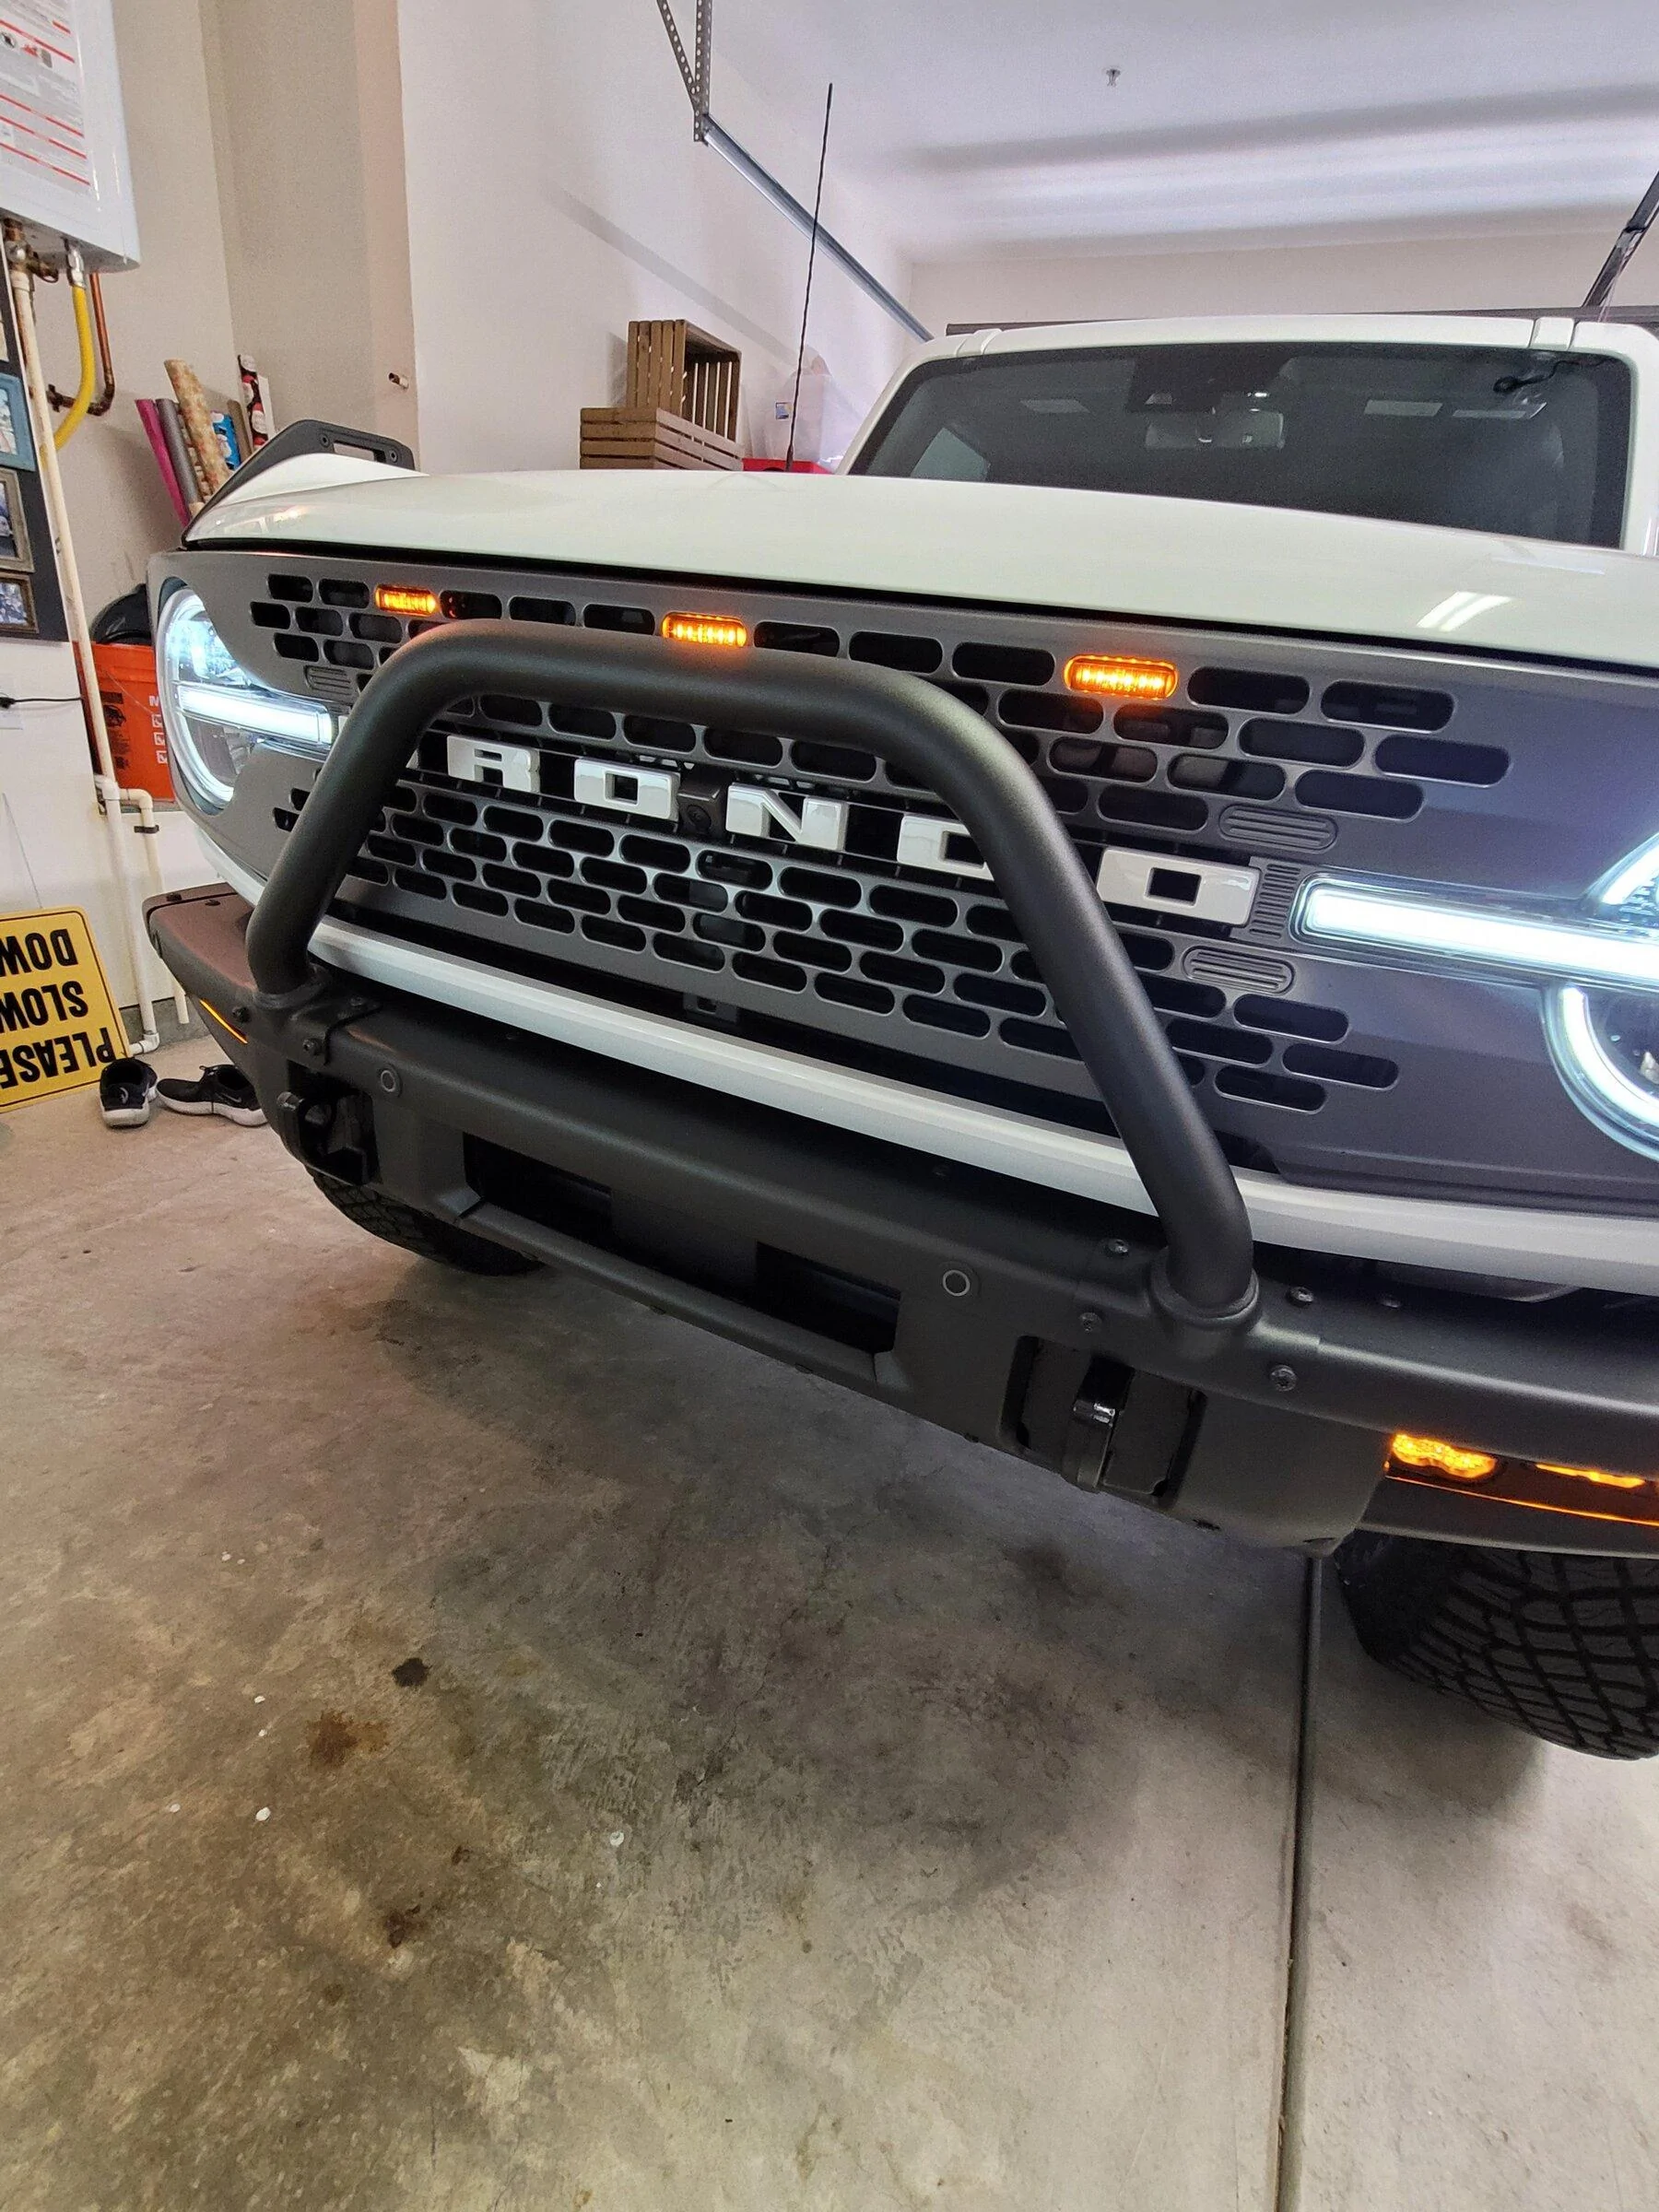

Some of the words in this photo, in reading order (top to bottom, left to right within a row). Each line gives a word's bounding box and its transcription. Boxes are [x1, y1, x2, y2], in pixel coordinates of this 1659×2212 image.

[406, 735, 1260, 927] RONCO
[0, 981, 88, 1031] SLOW
[0, 1028, 117, 1089] PLEASE
